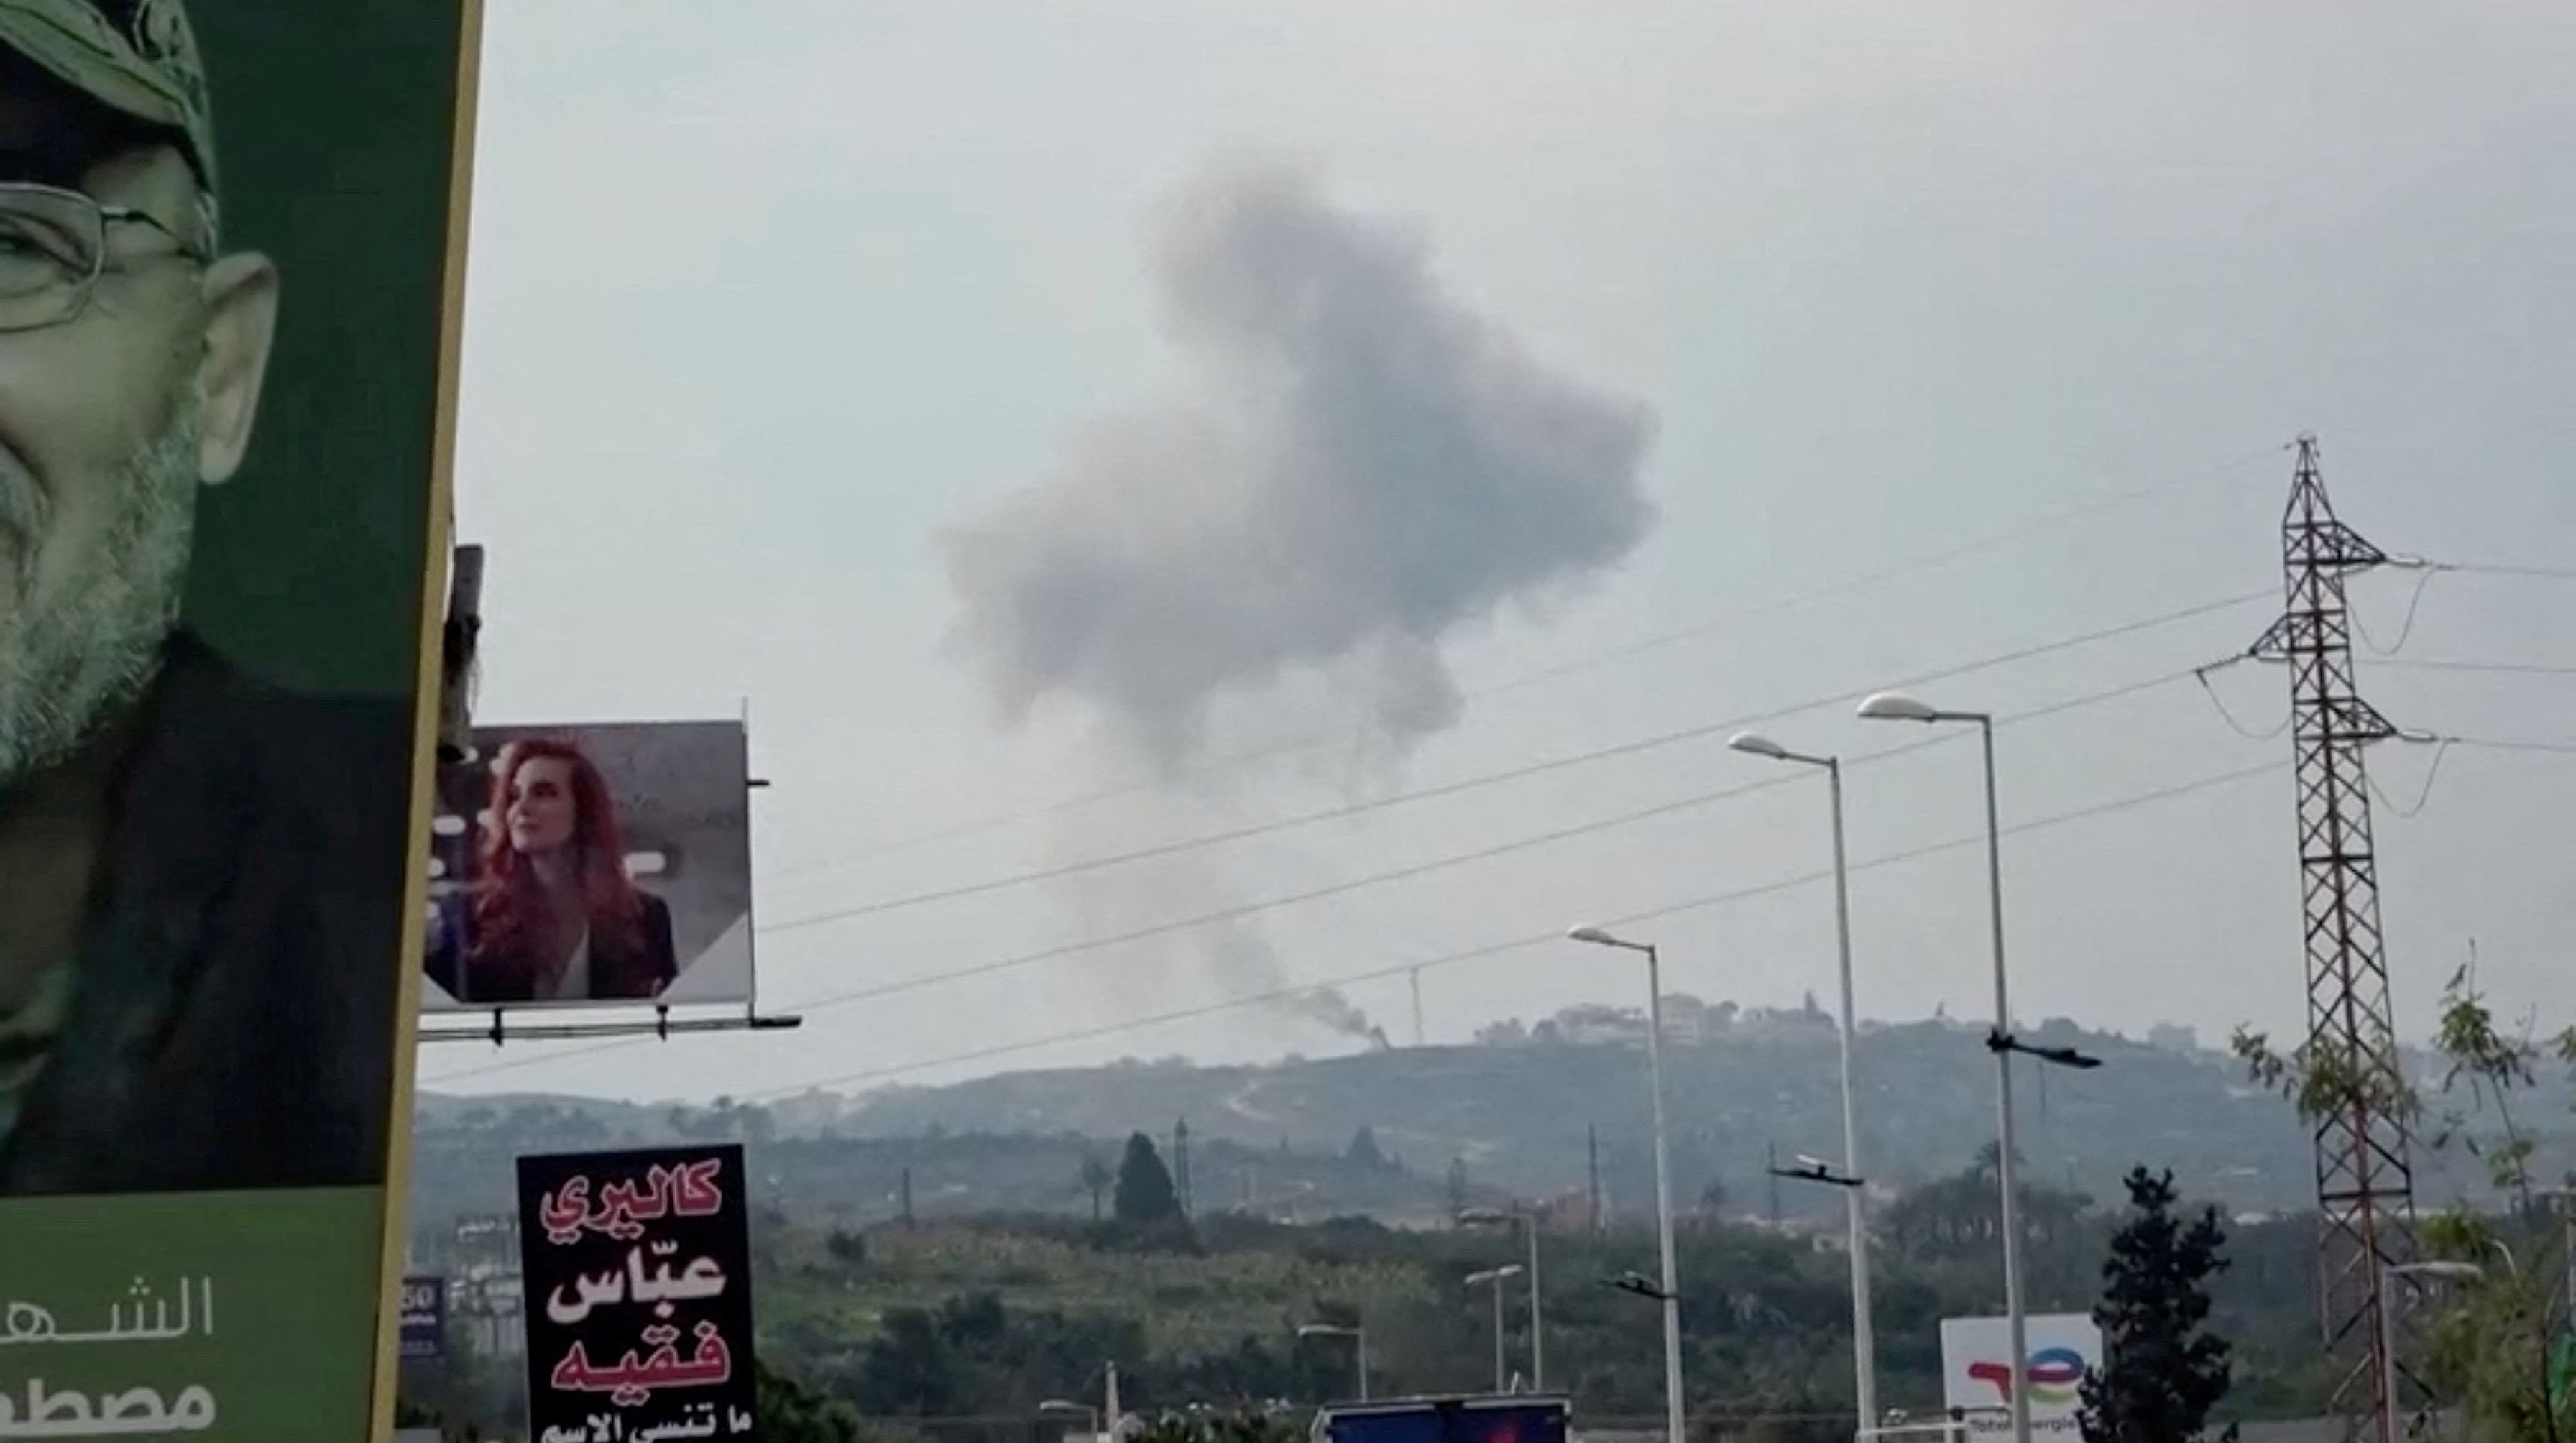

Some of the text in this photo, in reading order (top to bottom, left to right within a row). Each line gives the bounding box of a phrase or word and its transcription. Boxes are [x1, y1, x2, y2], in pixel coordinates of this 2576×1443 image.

[540, 1159, 723, 1243] كاليري
[0, 1276, 213, 1344] الشه
[551, 1321, 732, 1406] فقيه
[0, 1378, 216, 1436] مصط
[727, 1406, 753, 1434] ما
